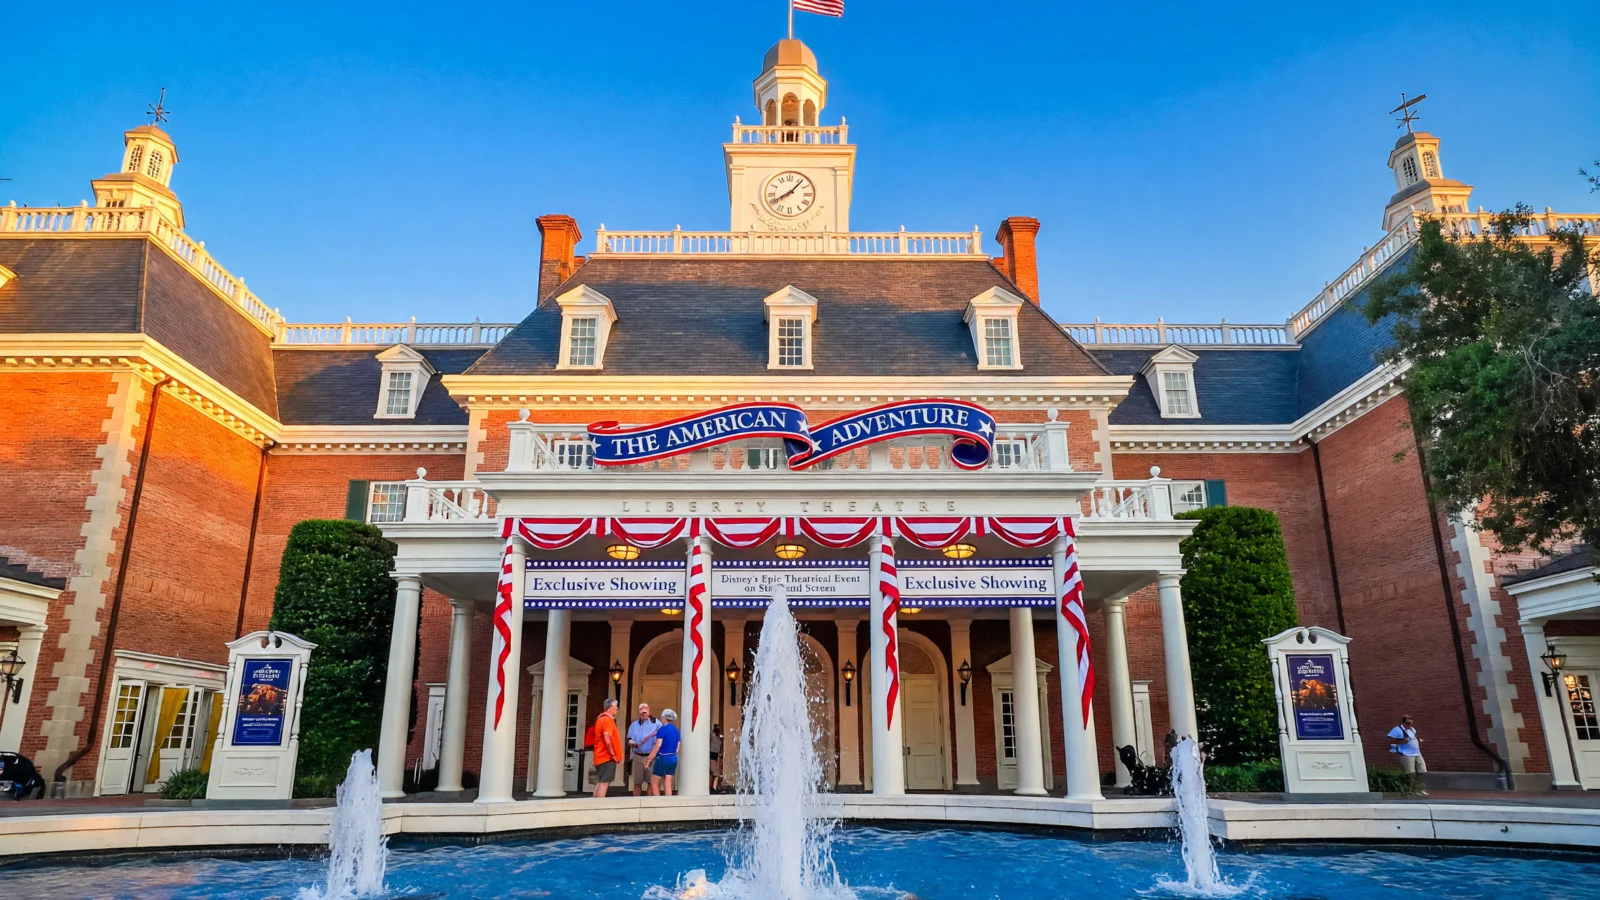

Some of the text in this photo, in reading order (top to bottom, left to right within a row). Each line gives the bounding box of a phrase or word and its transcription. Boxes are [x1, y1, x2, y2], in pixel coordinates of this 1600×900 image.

[612, 407, 970, 456] THE AMERICAN ADVENTURE
[622, 501, 956, 513] LIBERTY THEATRE
[532, 577, 677, 594] Exclusive Showing
[721, 574, 861, 584] Disney's Epic Theatrical Event
[905, 575, 1047, 593] Exclusive Showing
[759, 584, 784, 593] Sta
[785, 584, 802, 592] and
[805, 584, 836, 592] Screen
